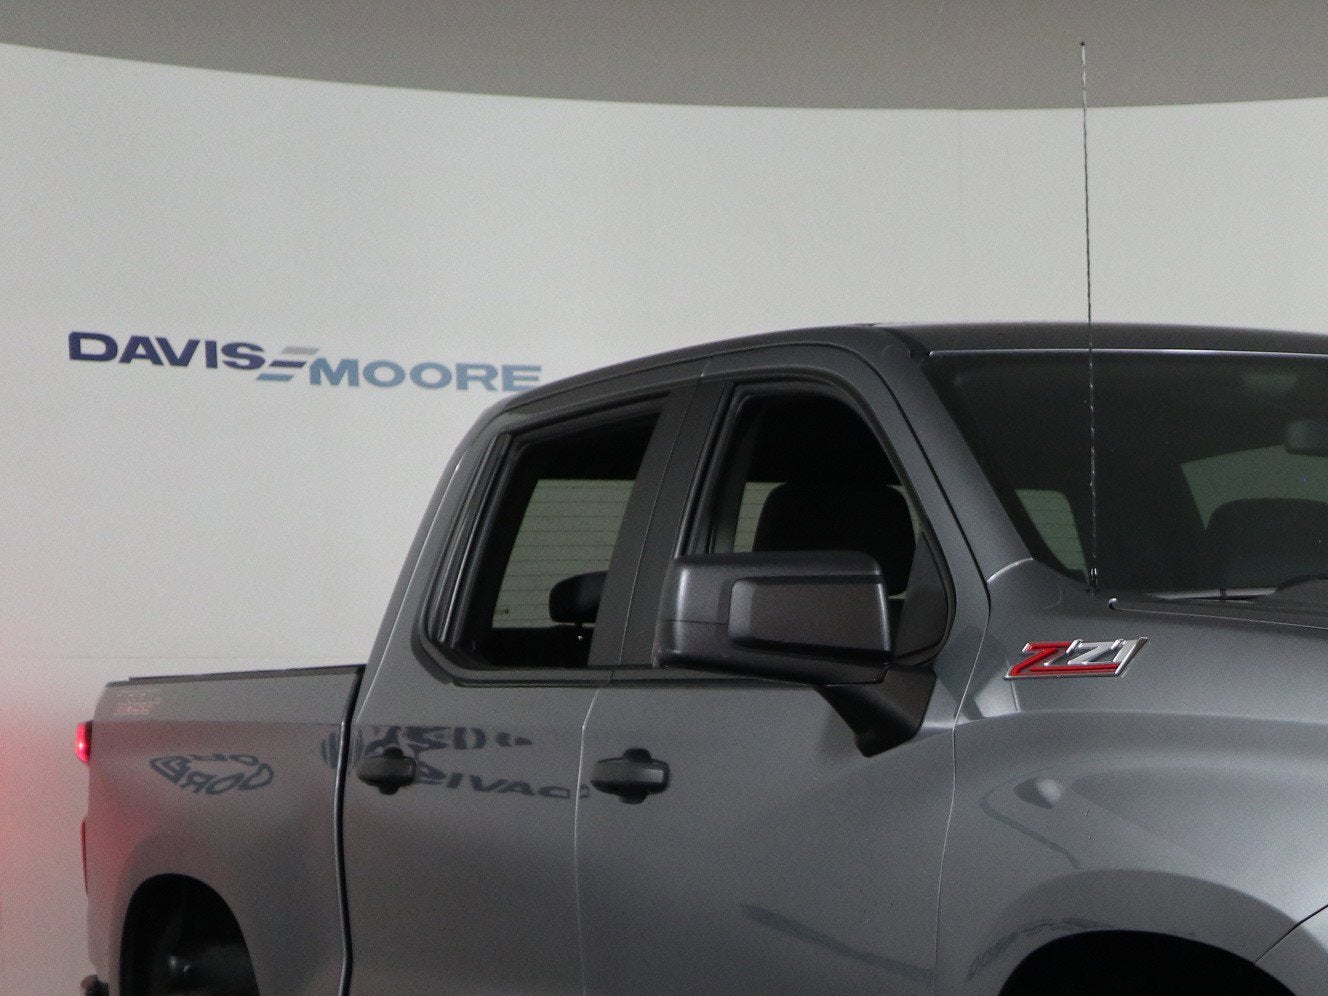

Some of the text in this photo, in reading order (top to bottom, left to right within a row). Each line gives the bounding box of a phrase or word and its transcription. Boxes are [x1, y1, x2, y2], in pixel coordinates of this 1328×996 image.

[68, 331, 542, 393] DAVIS MOORE
[1003, 637, 1148, 681] Z71
